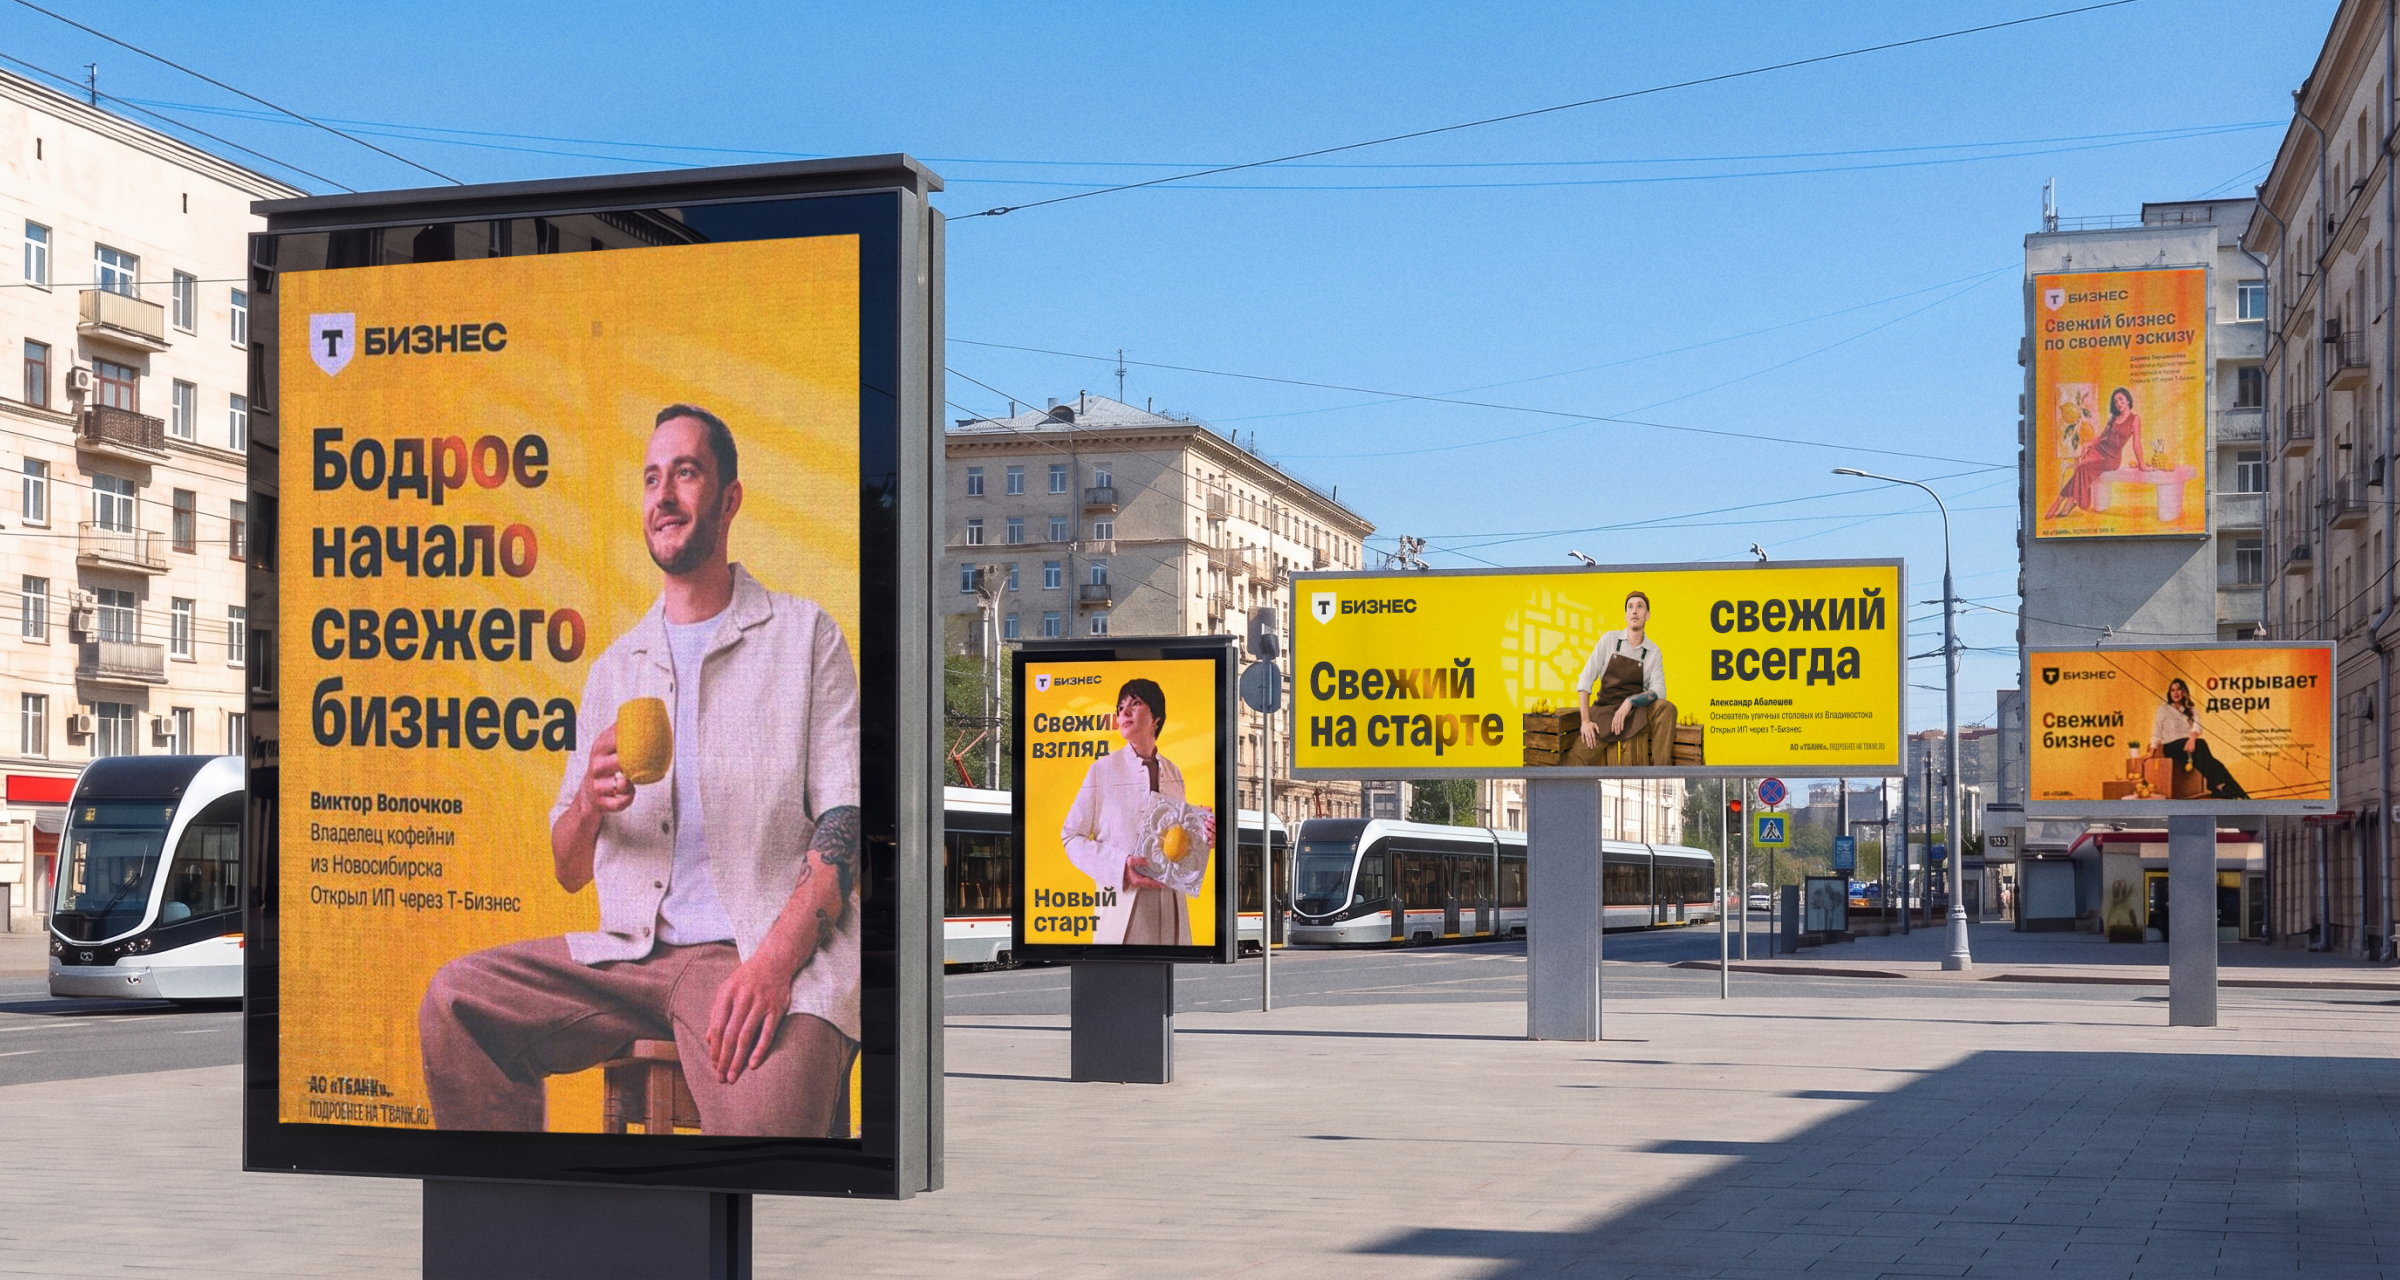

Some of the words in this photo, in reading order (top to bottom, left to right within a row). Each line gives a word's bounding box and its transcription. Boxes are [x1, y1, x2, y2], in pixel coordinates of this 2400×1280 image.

[2068, 290, 2129, 304] БИЗНЕС
[2045, 314, 2111, 333] Свежий
[2116, 313, 2176, 328] бизнес
[364, 322, 508, 356] БИЗНЕС
[2044, 336, 2066, 351] по
[2069, 334, 2131, 349] своему
[2136, 330, 2195, 345] эскизу
[312, 427, 549, 505] Бодрое
[312, 523, 538, 578] начало
[1340, 598, 1418, 615] БИЗНЕС
[1710, 587, 1886, 634] свежий
[311, 607, 586, 663] свежего
[1710, 645, 1861, 687] всегда
[2063, 670, 2116, 680] БИЗНЕС
[1054, 675, 1102, 686] БИЗНЕС
[1310, 657, 1475, 702] Свежий
[2206, 674, 2318, 693] открывает
[1710, 699, 1752, 708] Александр
[1754, 697, 1793, 706] Абалешев
[2206, 696, 2270, 714] двери
[311, 676, 577, 752] бизнеса
[1710, 712, 1749, 720] Основатель
[1751, 712, 1780, 721] уличных
[1782, 712, 1813, 720] столовых
[1825, 711, 1873, 720] Владивостока
[2043, 710, 2123, 728] Свежий
[1310, 715, 1357, 748] на
[1367, 713, 1504, 756] старте
[1710, 726, 1736, 735] Открыл
[1737, 725, 1748, 733] ИП
[1749, 727, 1769, 735] через
[1770, 725, 1802, 733] Т-Бизнес
[2043, 730, 2115, 749] бизнес
[1032, 740, 1110, 760] взгляд
[310, 791, 372, 815] Виктор
[377, 793, 463, 815] Волочков
[310, 823, 383, 846] Владелец
[387, 825, 455, 848] кофейни
[310, 858, 328, 874] из
[333, 855, 443, 880] Новосибирска
[310, 885, 369, 909] Открыл
[372, 888, 395, 907] ИП
[400, 893, 443, 913] через
[447, 890, 521, 913] Т-Бизнес
[1034, 886, 1117, 908] Новый
[1034, 916, 1100, 937] старт
[310, 1076, 327, 1093] АО
[310, 1101, 363, 1121] ПОДРОБНЕЕ
[366, 1104, 378, 1122] НА
